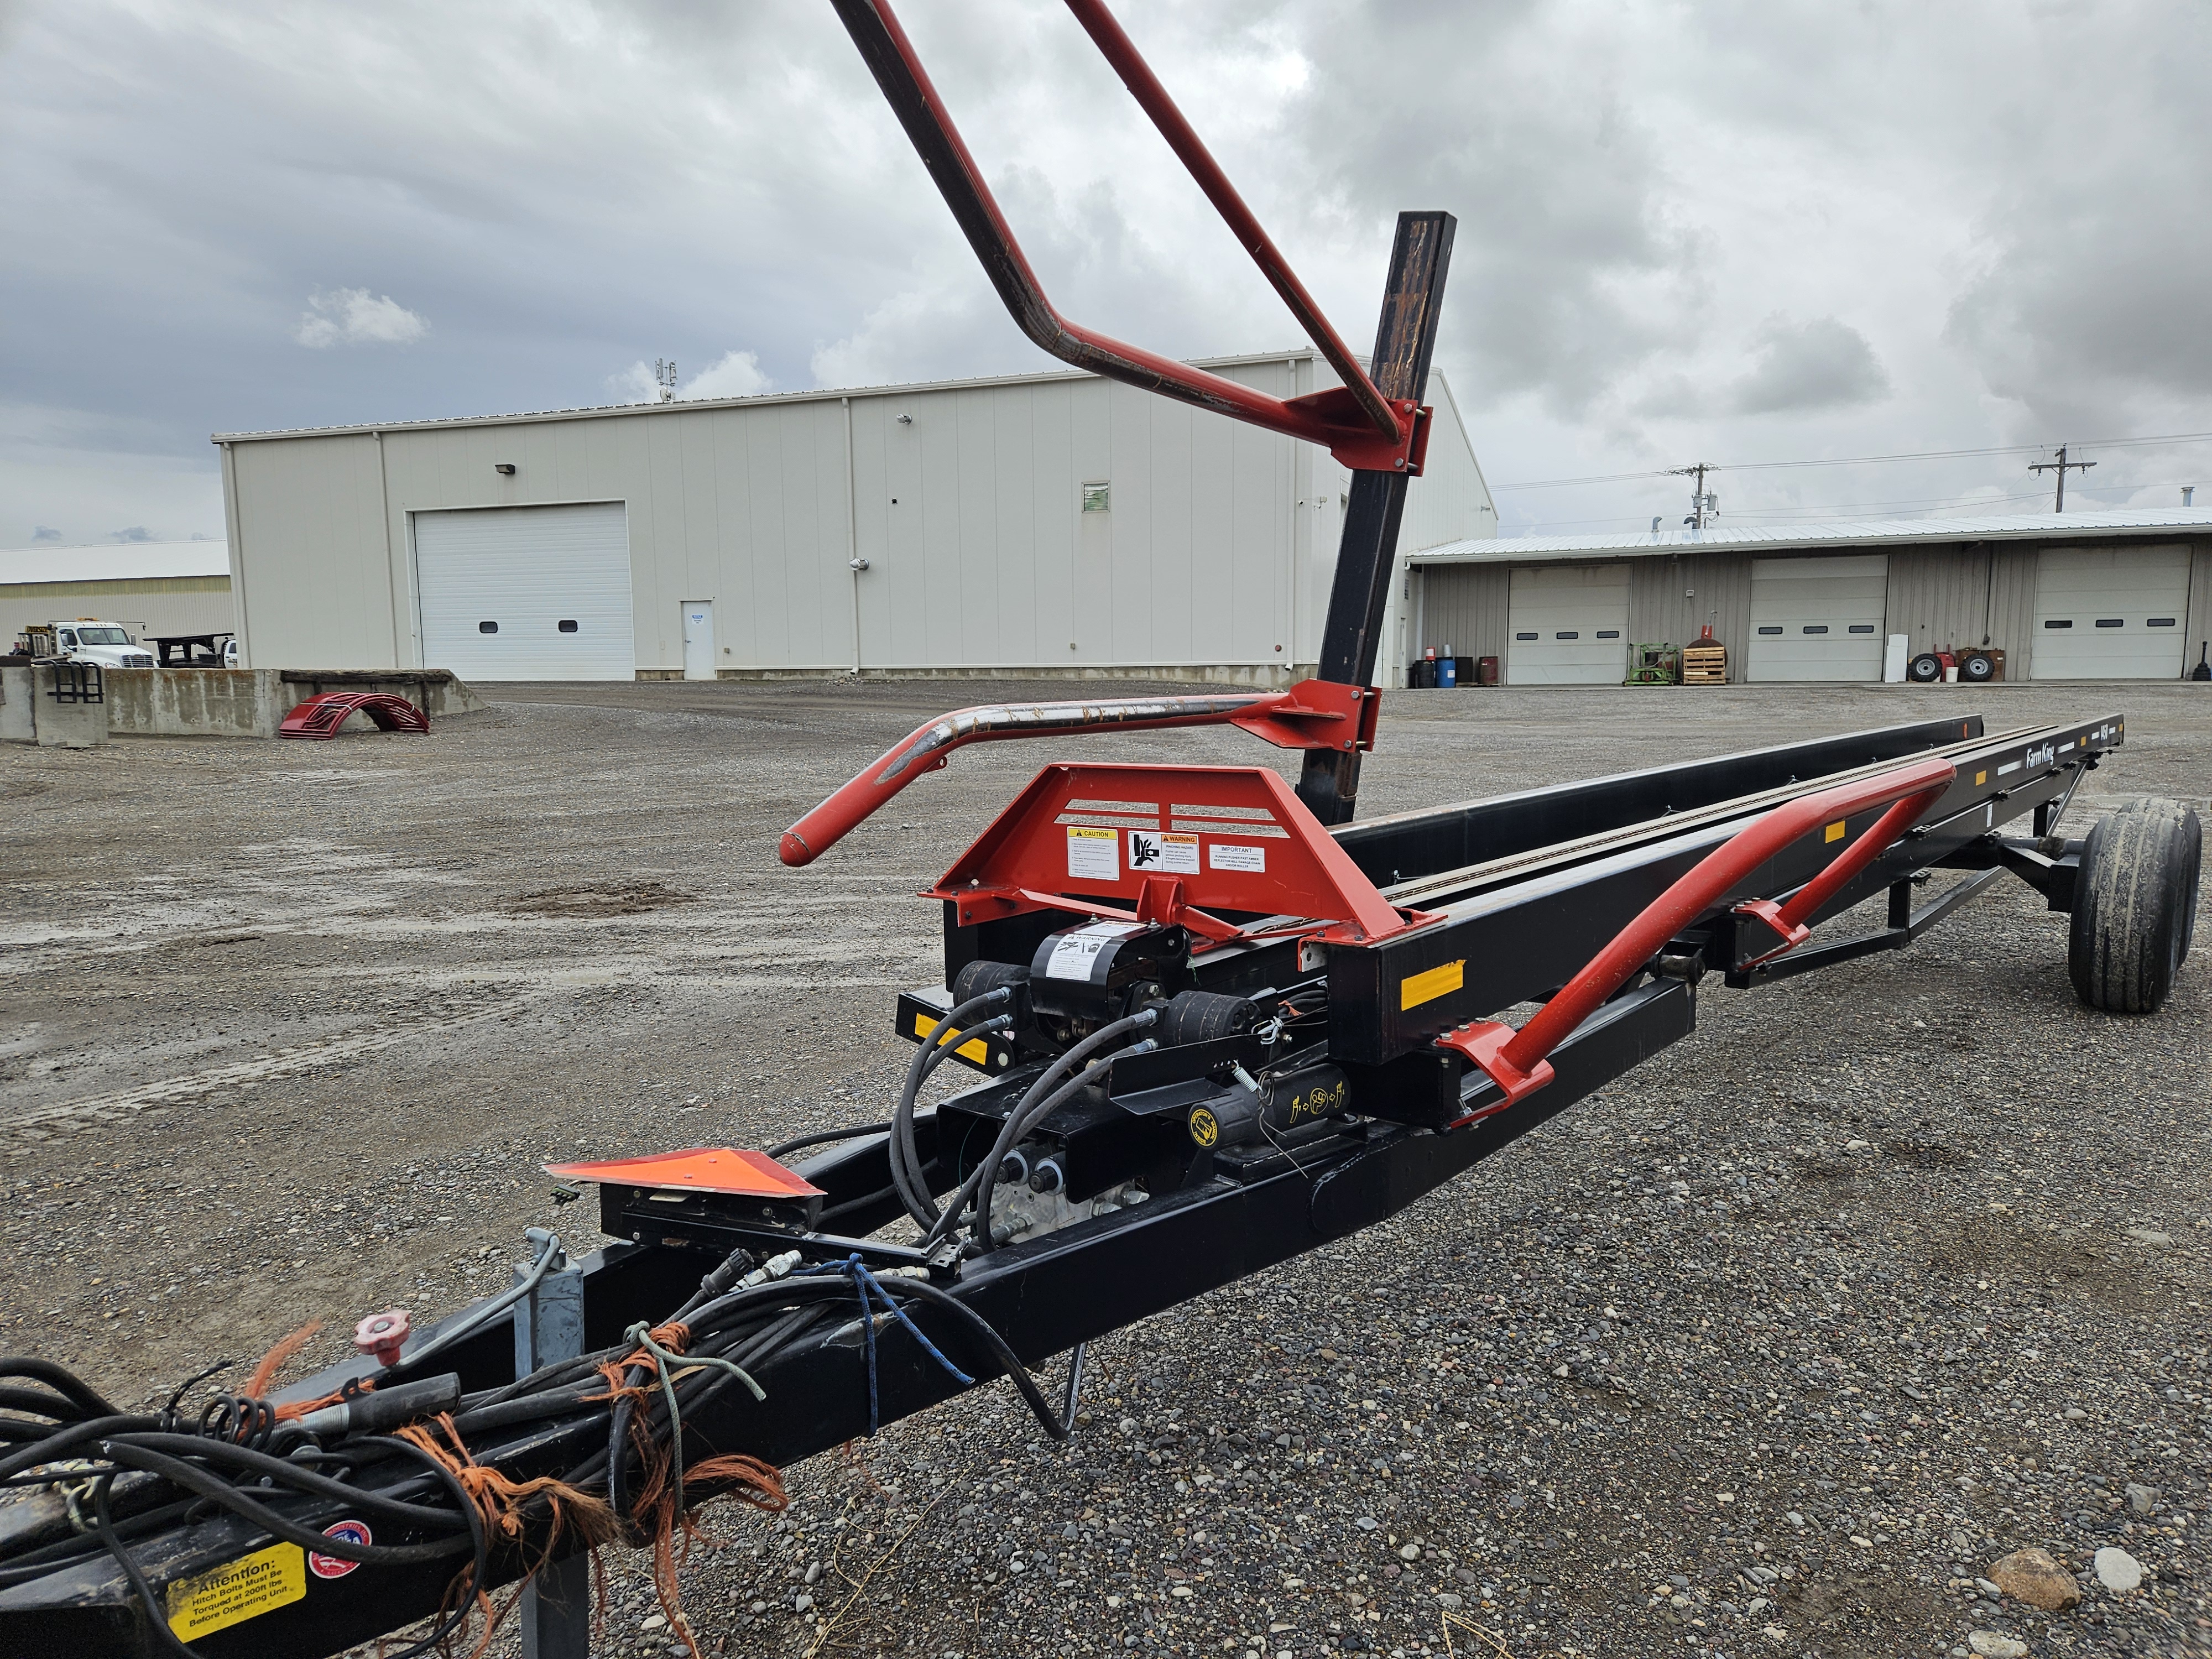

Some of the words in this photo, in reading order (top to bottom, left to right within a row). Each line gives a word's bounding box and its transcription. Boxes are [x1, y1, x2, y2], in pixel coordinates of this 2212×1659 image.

[2042, 742, 2054, 765] King
[1194, 1131, 1206, 1144] INSIDE
[192, 1594, 217, 1606] Hitch
[219, 1584, 243, 1597] Bolts
[246, 1574, 268, 1587] Must
[270, 1569, 283, 1578] Be
[198, 1560, 275, 1595] Attention:
[189, 1611, 220, 1627] Before
[222, 1594, 268, 1614] Operating
[269, 1585, 288, 1597] Unit
[193, 1597, 232, 1615] Torqued
[233, 1593, 242, 1601] at
[244, 1584, 267, 1598] 200ft
[269, 1579, 283, 1588] lbs
